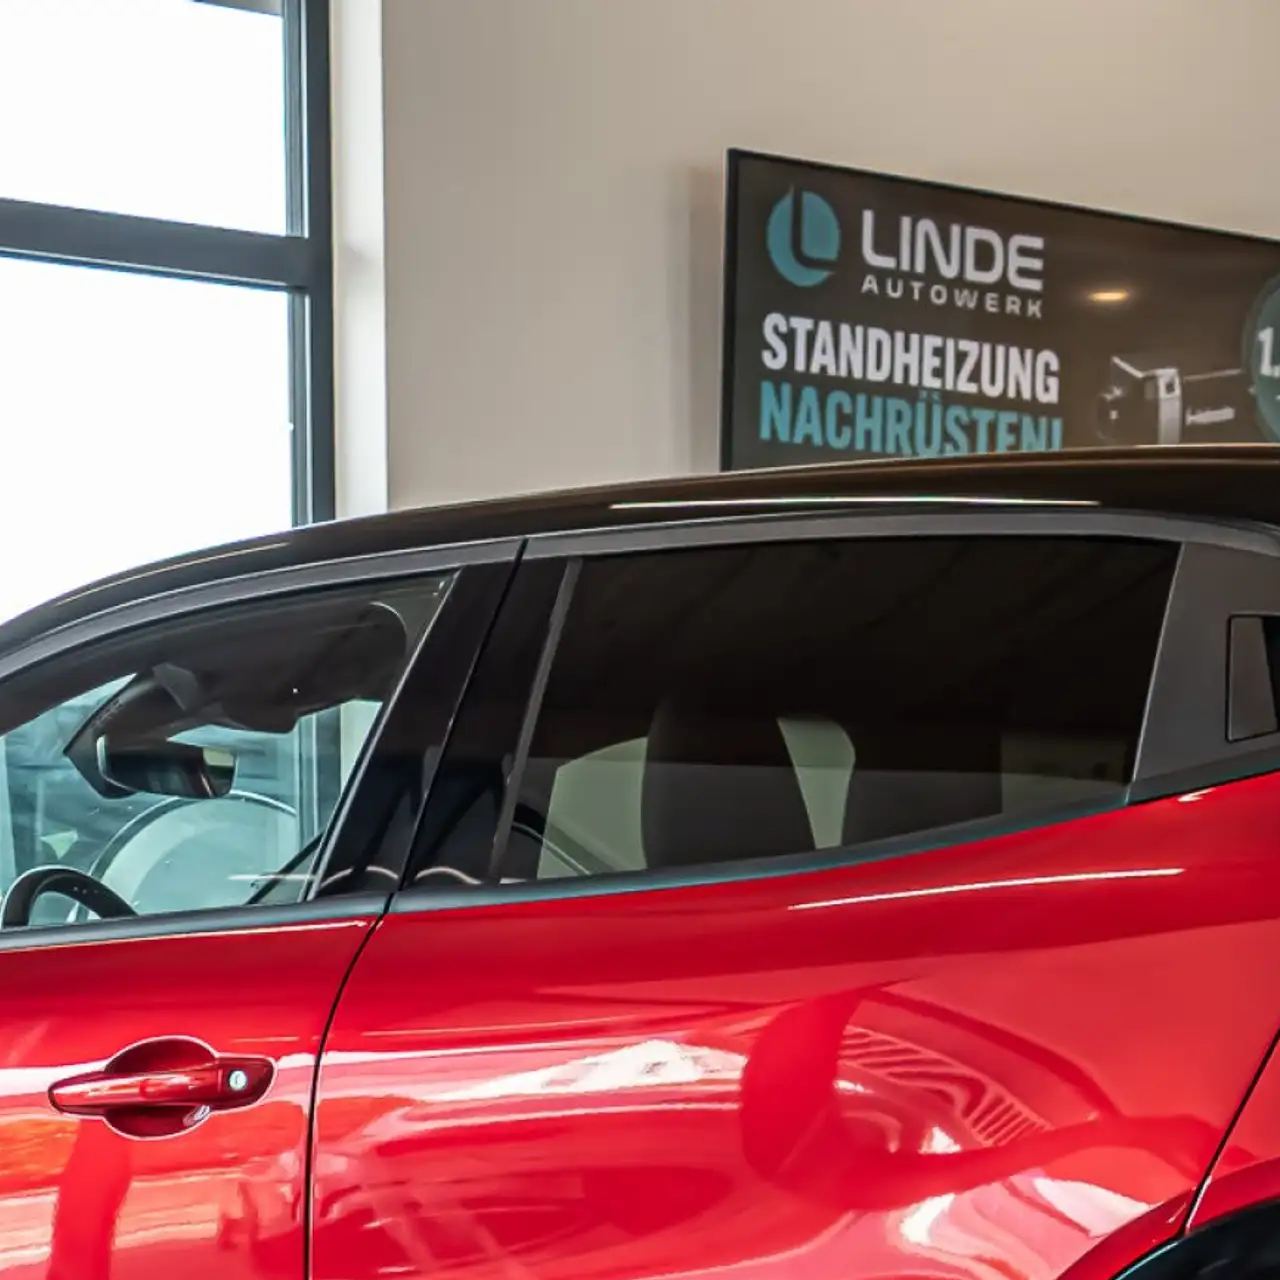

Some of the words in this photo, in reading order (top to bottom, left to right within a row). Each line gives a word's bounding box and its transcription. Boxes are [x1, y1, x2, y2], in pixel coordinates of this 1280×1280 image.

[861, 209, 1044, 292] LINDE
[860, 274, 1043, 319] AUTOWERK
[761, 312, 1059, 403] STANDHEIZUNG
